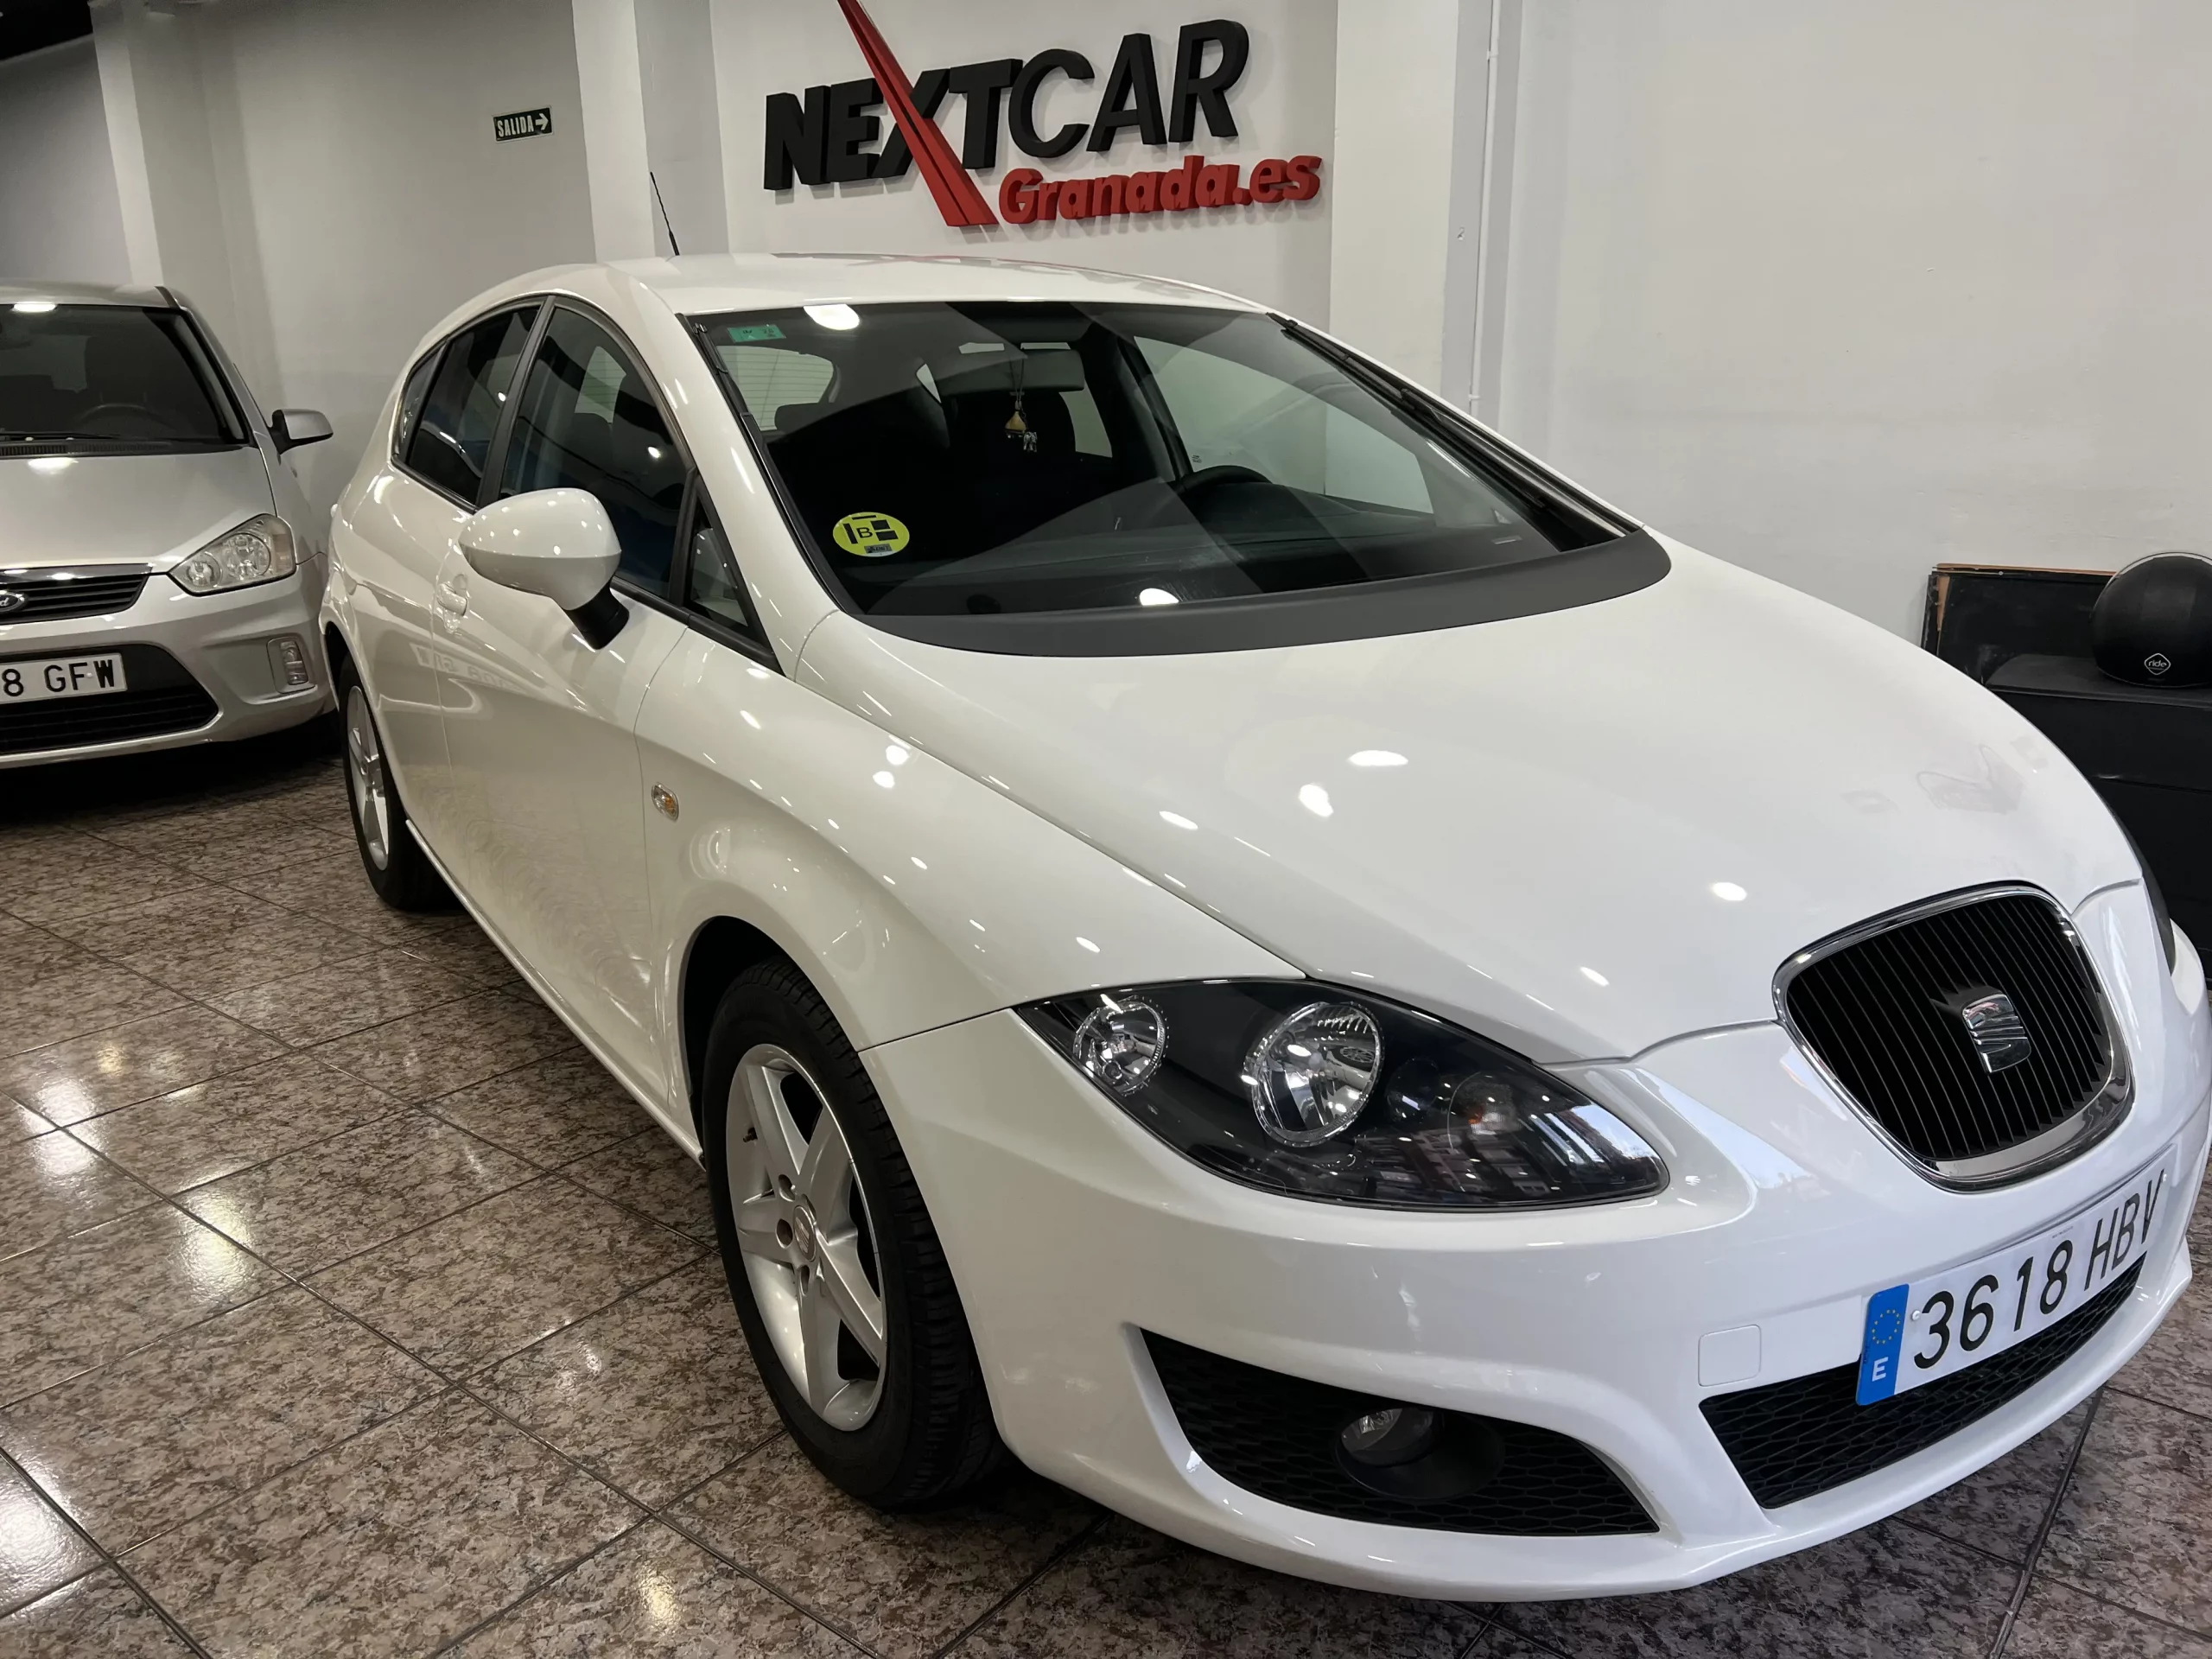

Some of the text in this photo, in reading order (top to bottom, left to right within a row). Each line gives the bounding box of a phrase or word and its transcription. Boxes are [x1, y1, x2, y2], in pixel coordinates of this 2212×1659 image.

[497, 115, 534, 137] SALIDA
[764, 0, 1250, 226] NEXTCAR
[999, 155, 1322, 224] Granada.es
[856, 527, 873, 538] B
[2, 659, 114, 696] 8 GFW
[1872, 1168, 2164, 1382] E 3618 HBV
